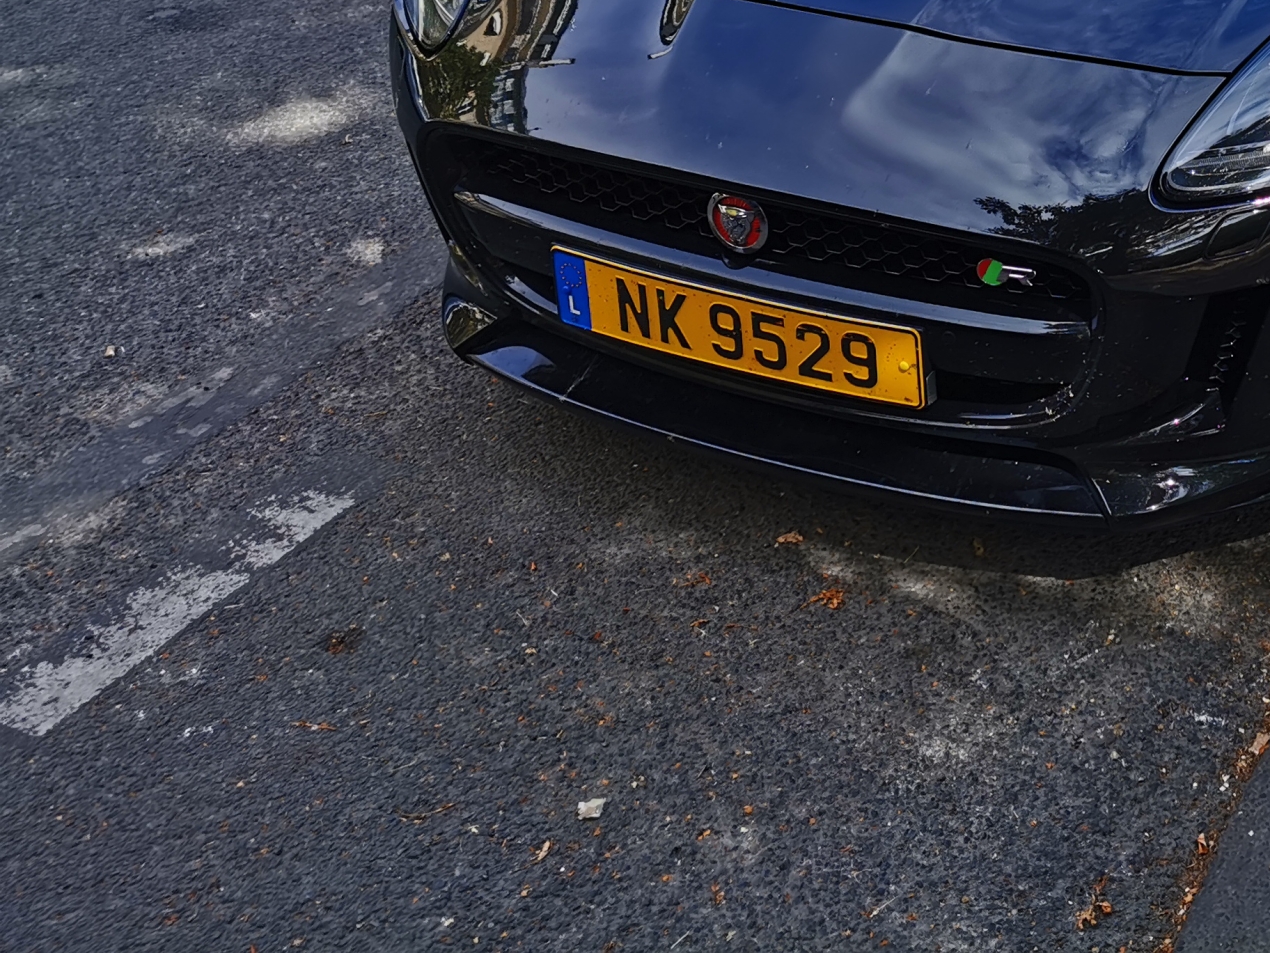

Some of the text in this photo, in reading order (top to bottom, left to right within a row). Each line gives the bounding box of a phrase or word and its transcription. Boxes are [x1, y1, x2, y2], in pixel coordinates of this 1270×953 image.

[568, 295, 581, 315] L
[615, 276, 879, 389] NK 9529
